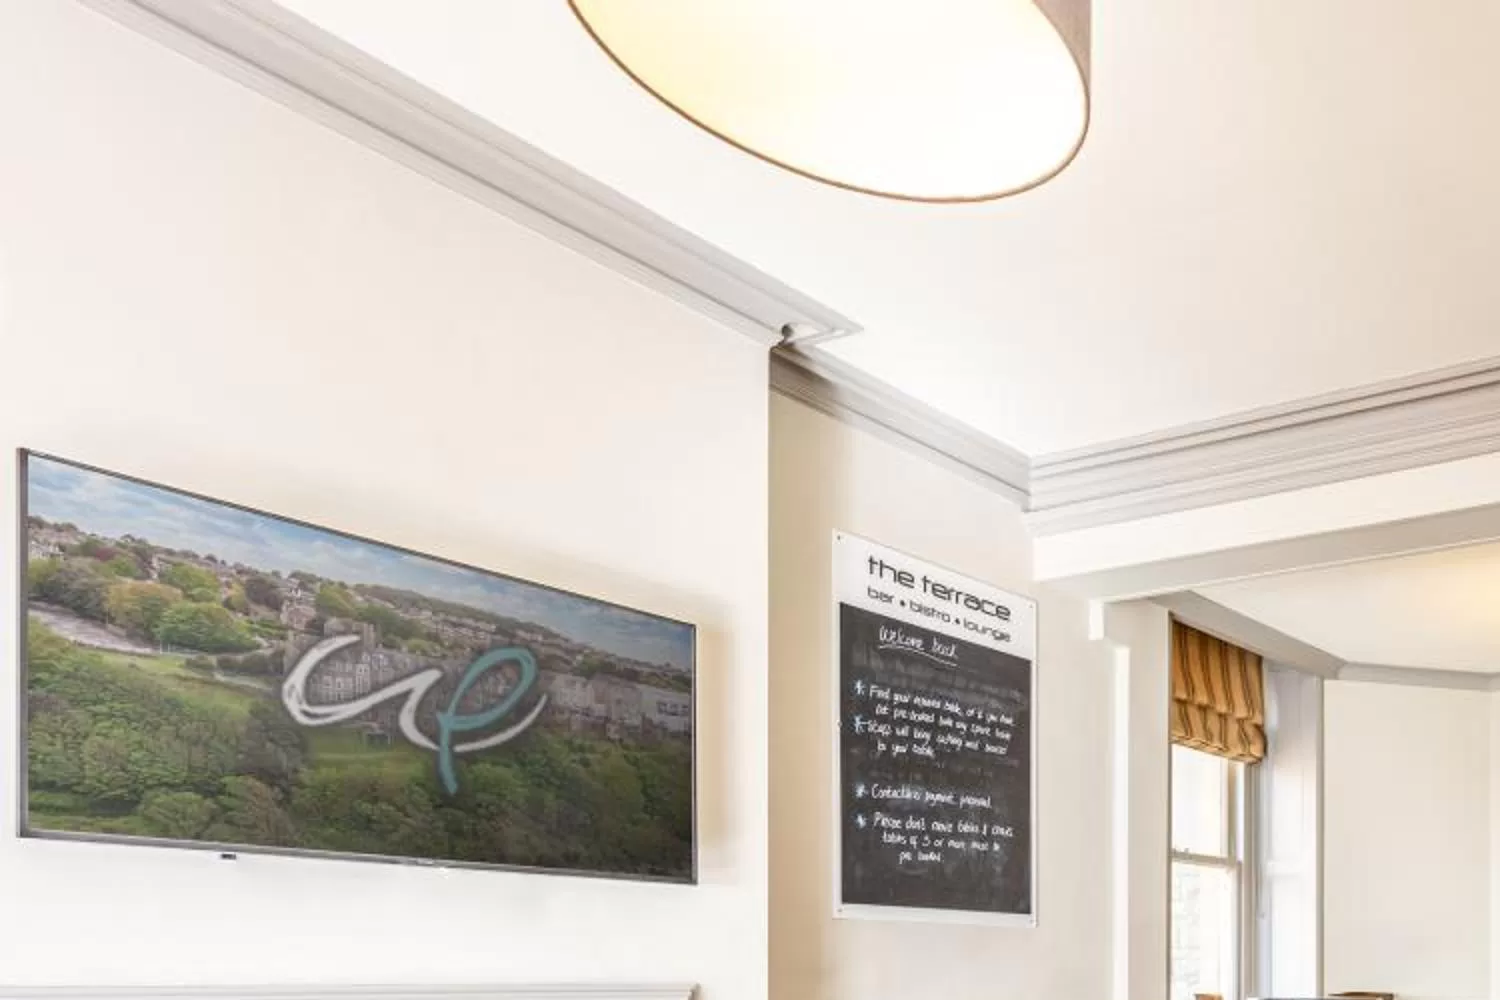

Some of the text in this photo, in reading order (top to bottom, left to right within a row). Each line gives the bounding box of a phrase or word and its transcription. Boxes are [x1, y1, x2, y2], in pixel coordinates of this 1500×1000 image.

[867, 586, 1011, 642] bar bistro lounge
[868, 555, 1011, 621] the terrace
